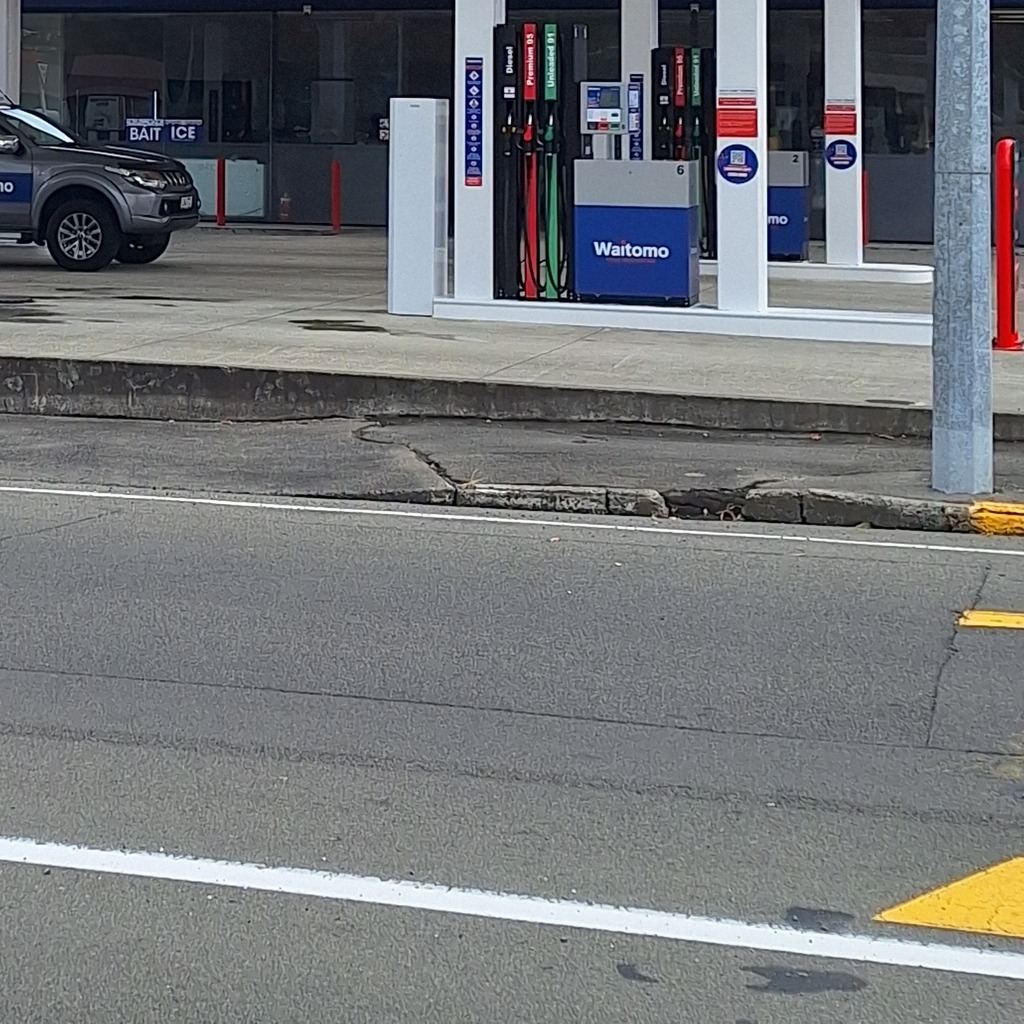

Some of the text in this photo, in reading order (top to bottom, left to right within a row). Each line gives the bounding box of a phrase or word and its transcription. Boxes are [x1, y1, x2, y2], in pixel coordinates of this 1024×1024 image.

[505, 46, 514, 74] Diesel
[526, 47, 534, 86] Premium
[547, 45, 556, 87] Unleaded
[130, 127, 161, 141] BAIT
[171, 126, 196, 140] ICE
[792, 154, 799, 163] 2
[676, 164, 685, 176] 6
[593, 239, 670, 258] Waitomo
